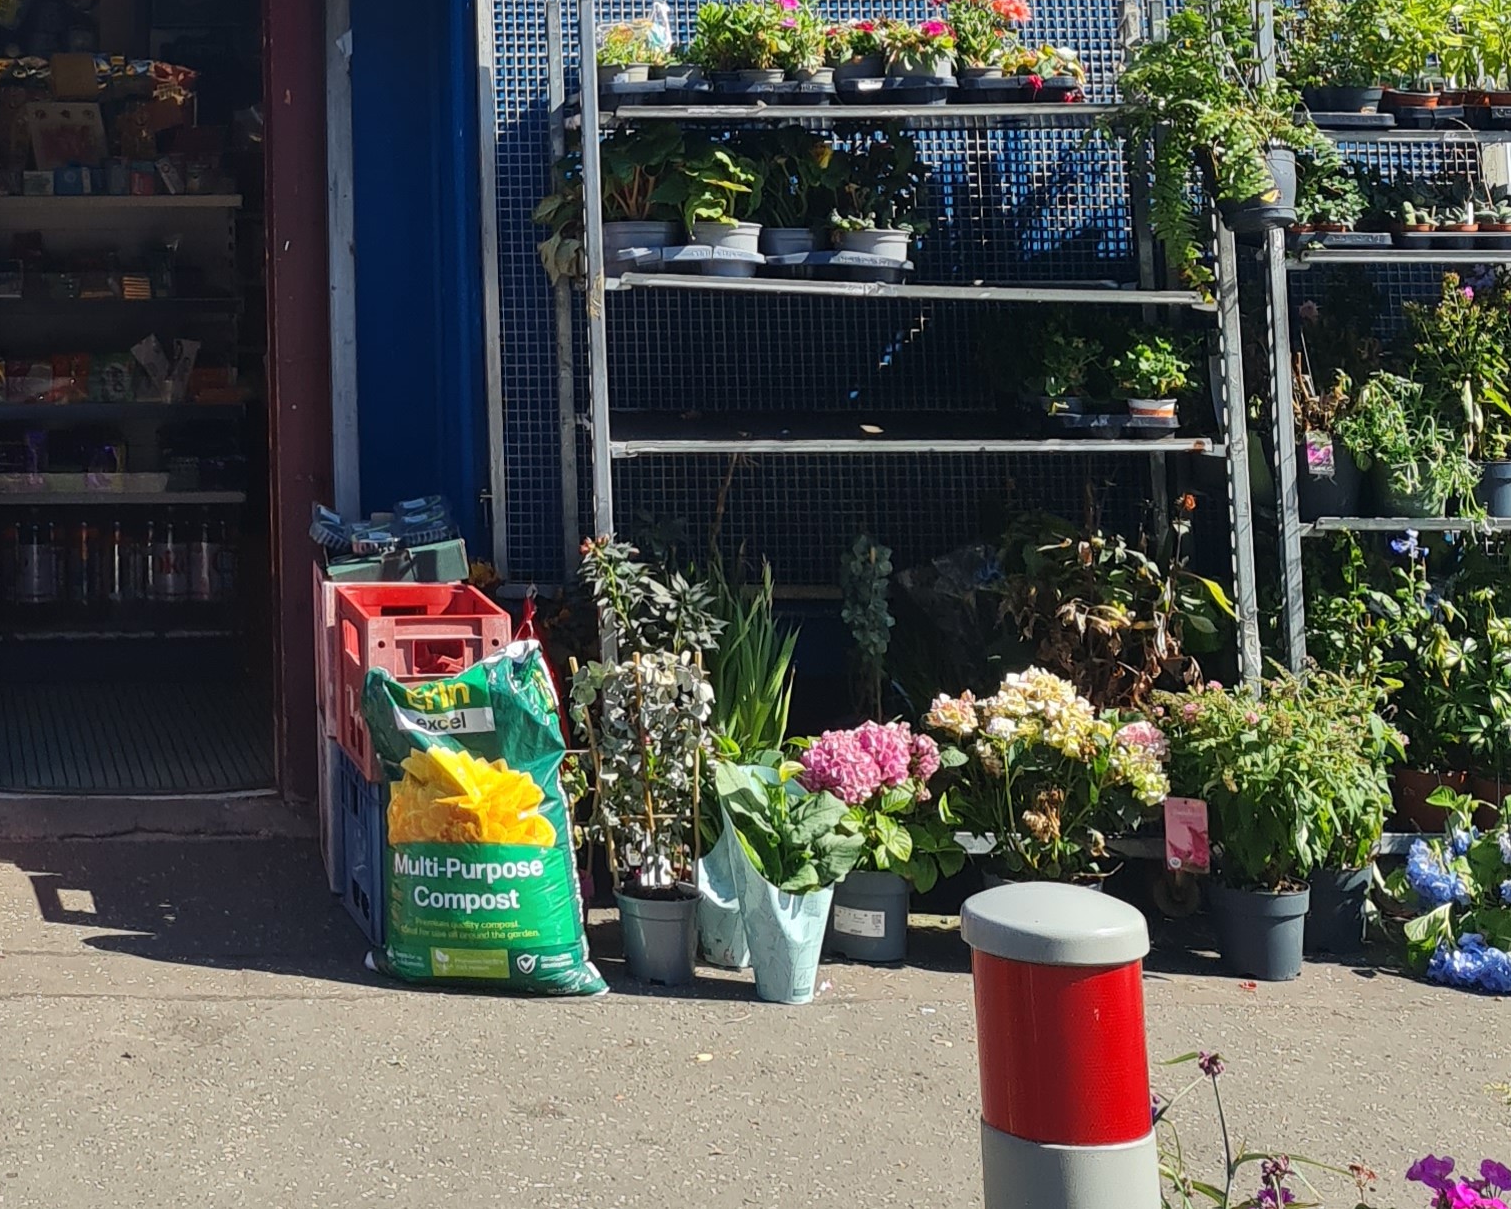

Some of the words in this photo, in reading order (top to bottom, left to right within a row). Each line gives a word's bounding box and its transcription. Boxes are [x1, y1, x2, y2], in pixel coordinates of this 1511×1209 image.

[416, 712, 467, 731] excel
[394, 853, 545, 885] Multi-Purpose
[414, 886, 521, 914] Compost
[491, 930, 505, 939] the
